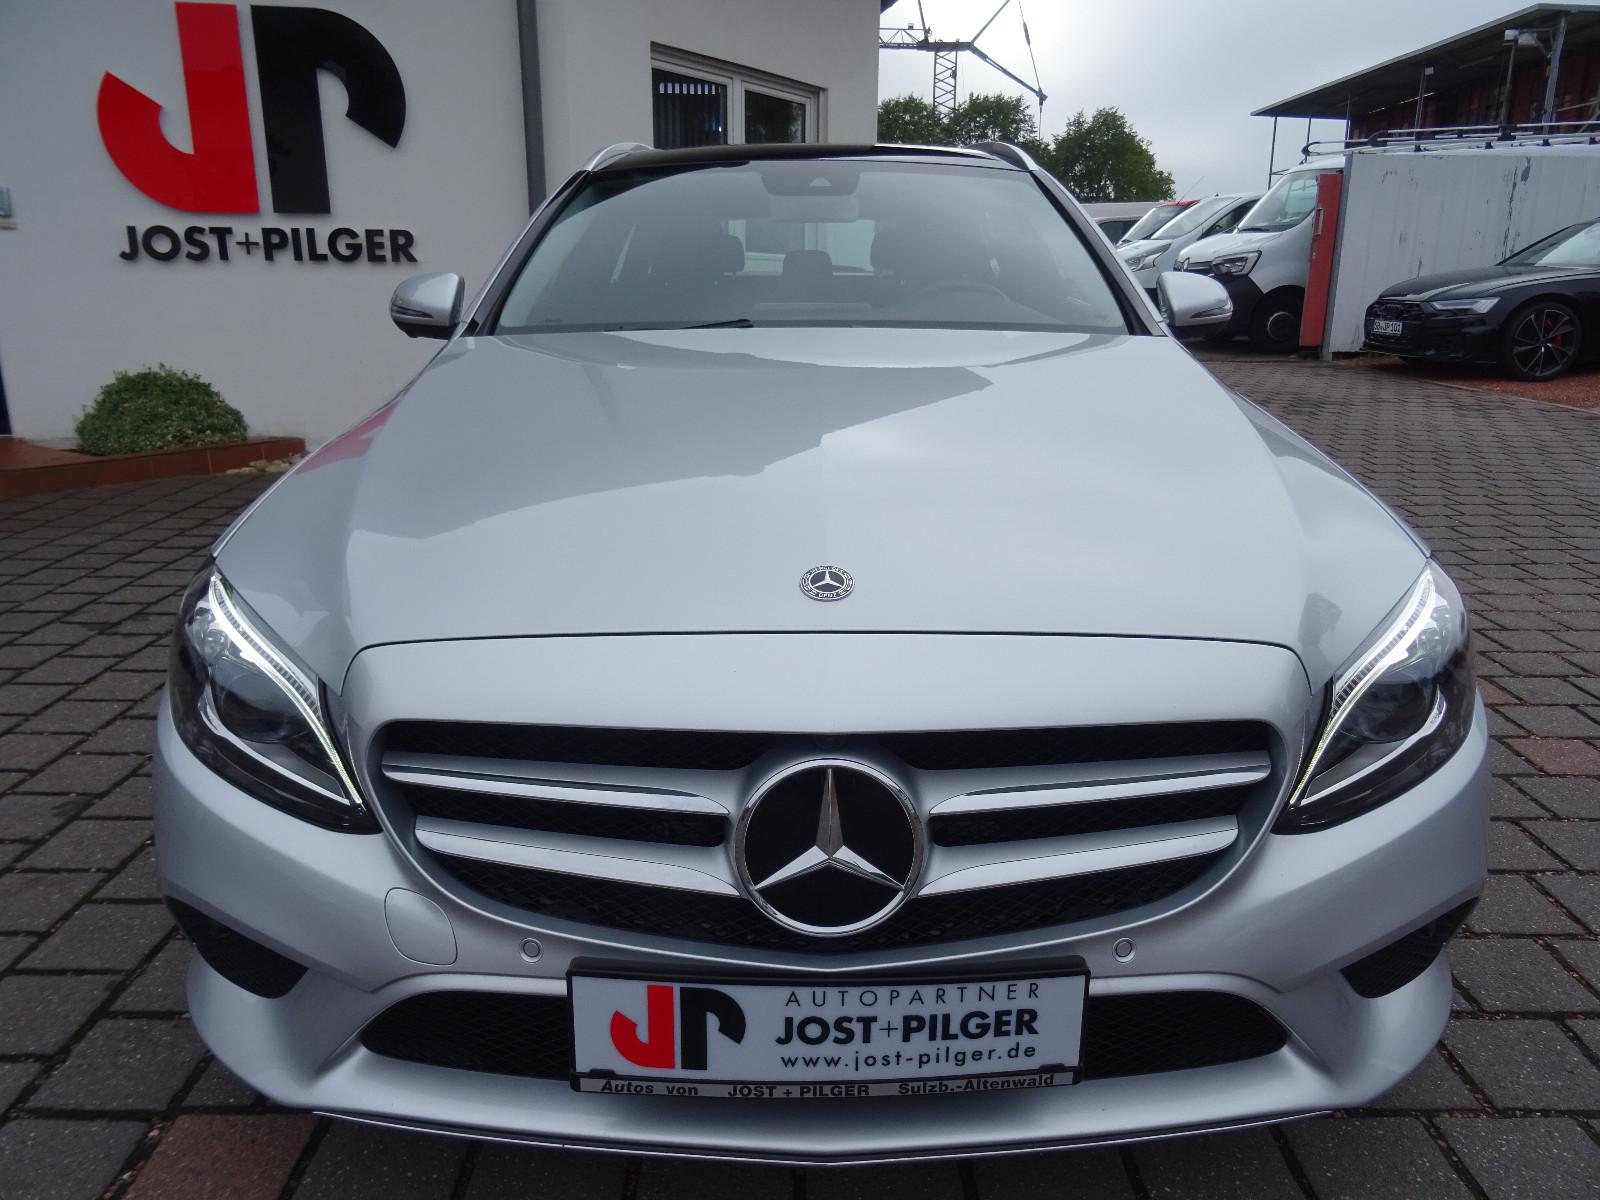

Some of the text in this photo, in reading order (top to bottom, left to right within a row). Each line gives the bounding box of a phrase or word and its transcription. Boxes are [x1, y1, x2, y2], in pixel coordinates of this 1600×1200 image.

[119, 225, 418, 262] JOST+PILGER
[785, 982, 1039, 1007] AUTOPARTNER
[775, 1008, 1039, 1046] JOST+PILGER
[780, 1042, 1037, 1071] www.jost-pilger.de
[601, 1073, 1055, 1097] Autos von JOST + PILGER Sulzb.-Altenwald
